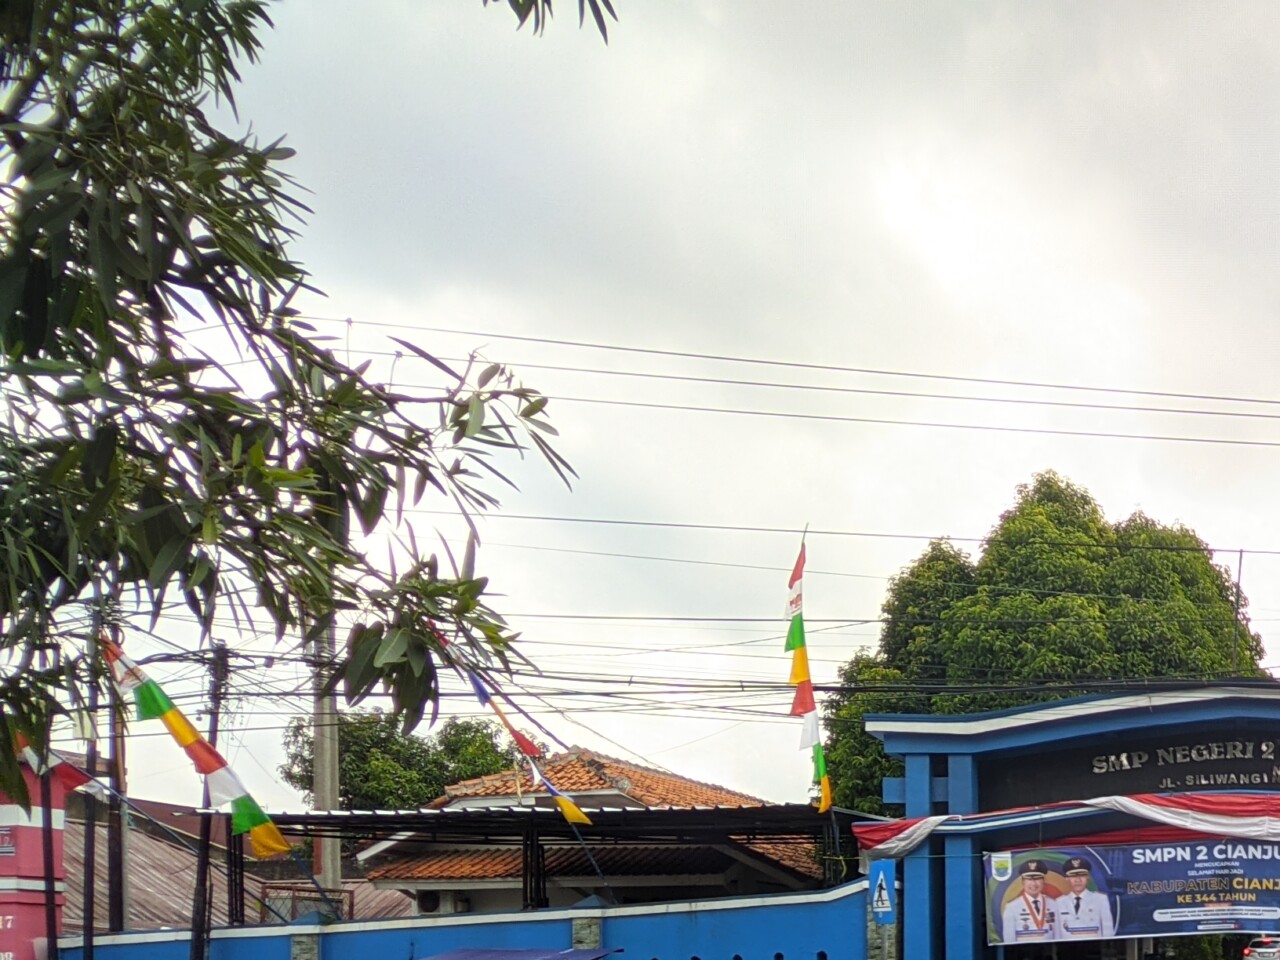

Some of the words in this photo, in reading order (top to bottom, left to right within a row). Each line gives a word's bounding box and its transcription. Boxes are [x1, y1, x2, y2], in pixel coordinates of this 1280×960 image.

[1092, 751, 1149, 773] SMP
[1156, 742, 1253, 766] NEGERI
[1261, 741, 1274, 760] 2
[1185, 773, 1268, 785] SILIWANGI
[1132, 847, 1191, 864] SMPN
[1196, 846, 1208, 860] 2
[1127, 878, 1229, 895] KABUPATEN
[1177, 894, 1192, 904] KE
[1194, 893, 1217, 903] 344
[1218, 893, 1256, 902] TAHUN
